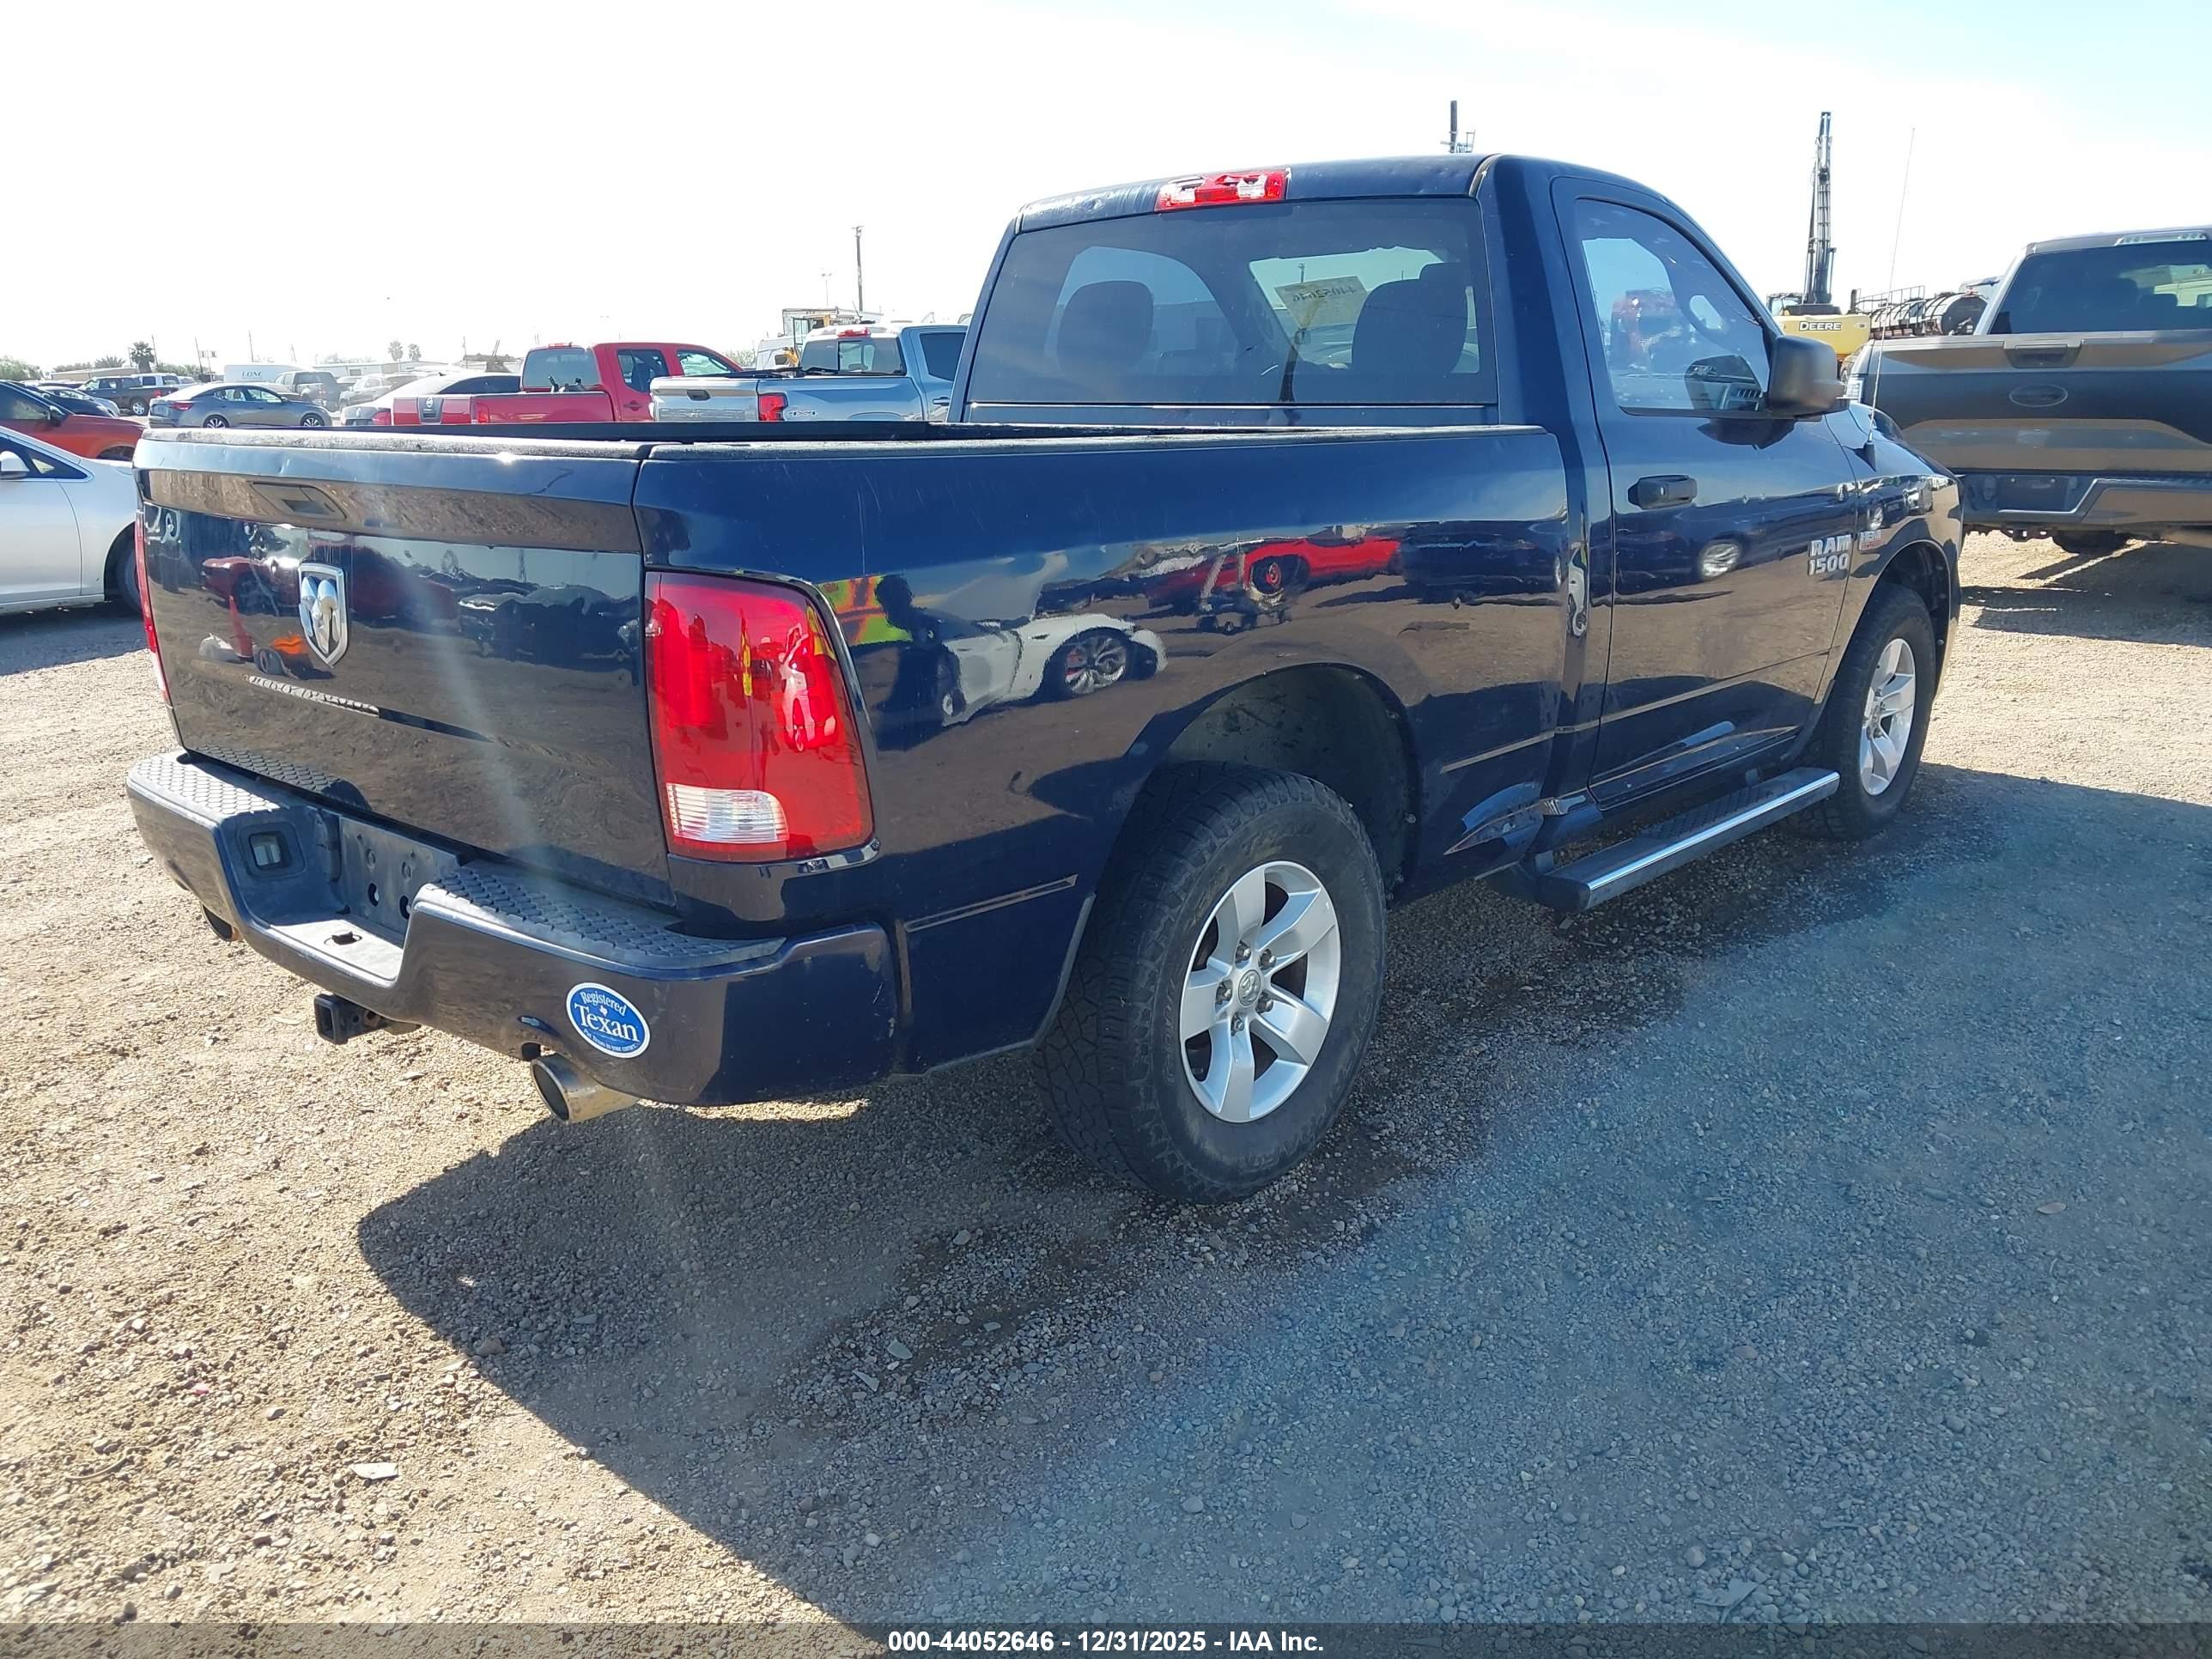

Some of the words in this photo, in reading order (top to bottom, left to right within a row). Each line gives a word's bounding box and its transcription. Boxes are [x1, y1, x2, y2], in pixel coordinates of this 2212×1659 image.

[1799, 320, 1842, 331] DEERE
[1808, 534, 1852, 557] RAM
[1808, 553, 1850, 576] 1500
[580, 990, 628, 1017] Registered
[574, 1002, 641, 1043] Texan
